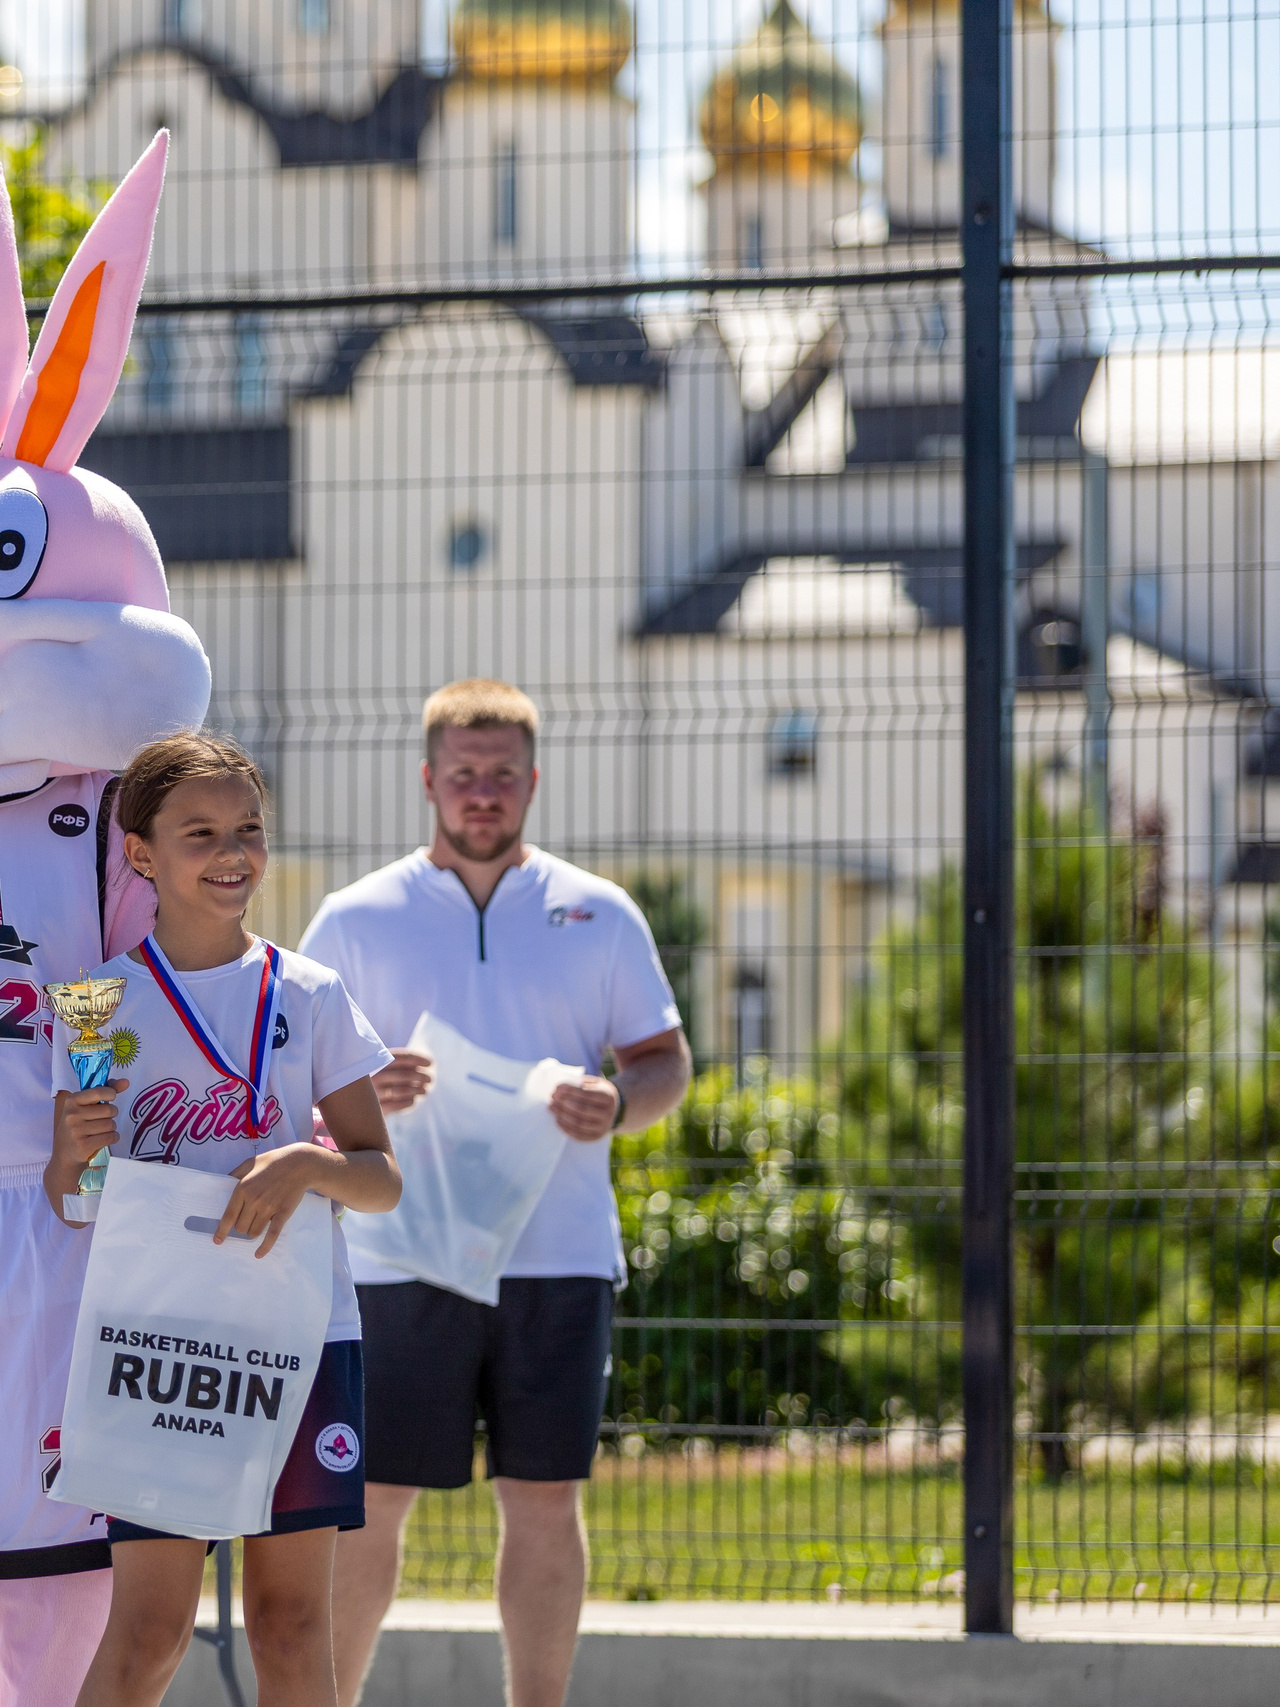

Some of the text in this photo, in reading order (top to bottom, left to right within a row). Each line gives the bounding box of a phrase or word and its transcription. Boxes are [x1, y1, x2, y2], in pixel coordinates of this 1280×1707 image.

[52, 814, 86, 828] РФБ
[99, 1326, 301, 1372] BASKETBALL CLUB
[107, 1352, 284, 1422] RUBIN
[151, 1412, 226, 1438] ANAPA
